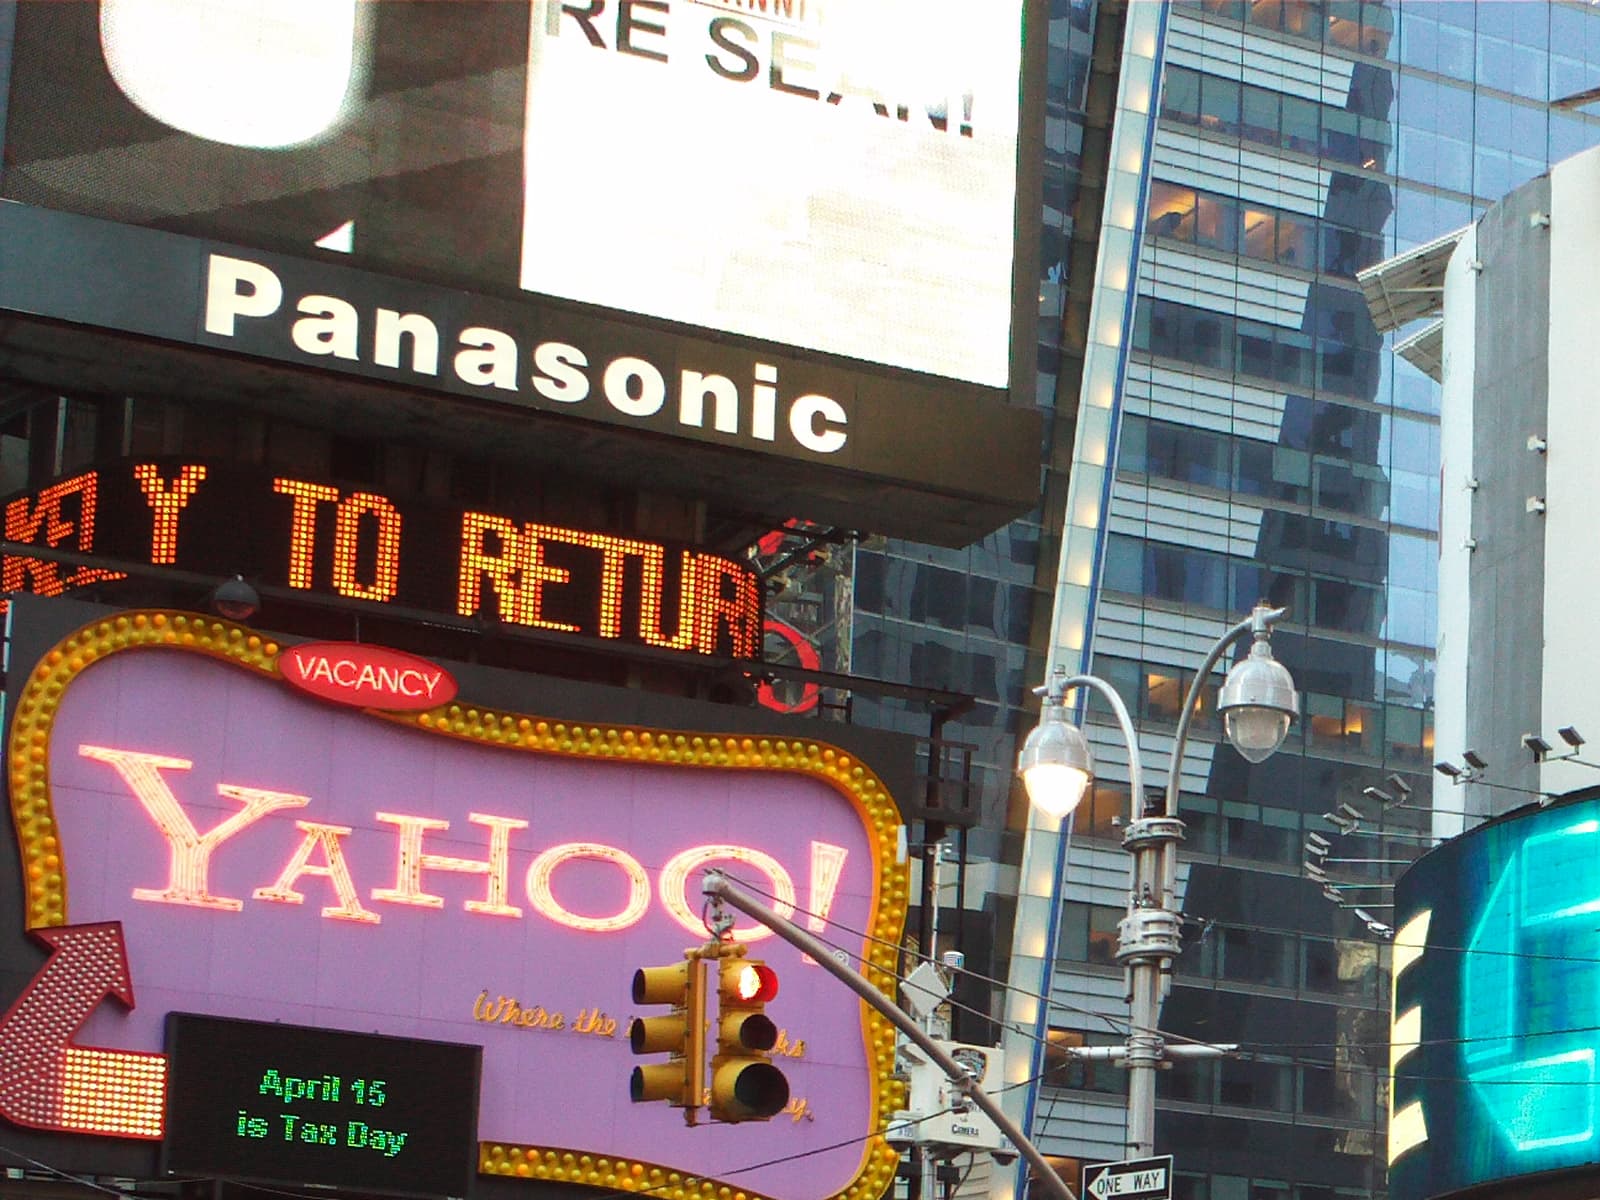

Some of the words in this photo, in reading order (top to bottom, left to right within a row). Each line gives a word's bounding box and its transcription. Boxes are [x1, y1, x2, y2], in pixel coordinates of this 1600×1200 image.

[205, 253, 849, 456] Panasonic
[273, 477, 401, 602] TO
[292, 651, 442, 701] VACANCY
[77, 743, 850, 967] YAHOO!
[472, 989, 566, 1031] Where
[571, 1006, 617, 1039] the
[258, 1068, 341, 1104] April
[351, 1078, 387, 1107] 15
[236, 1110, 269, 1139] is
[280, 1114, 337, 1145] Tax
[346, 1121, 409, 1158] Day
[1096, 1176, 1122, 1194] ONE
[1132, 1171, 1161, 1191] WAY
